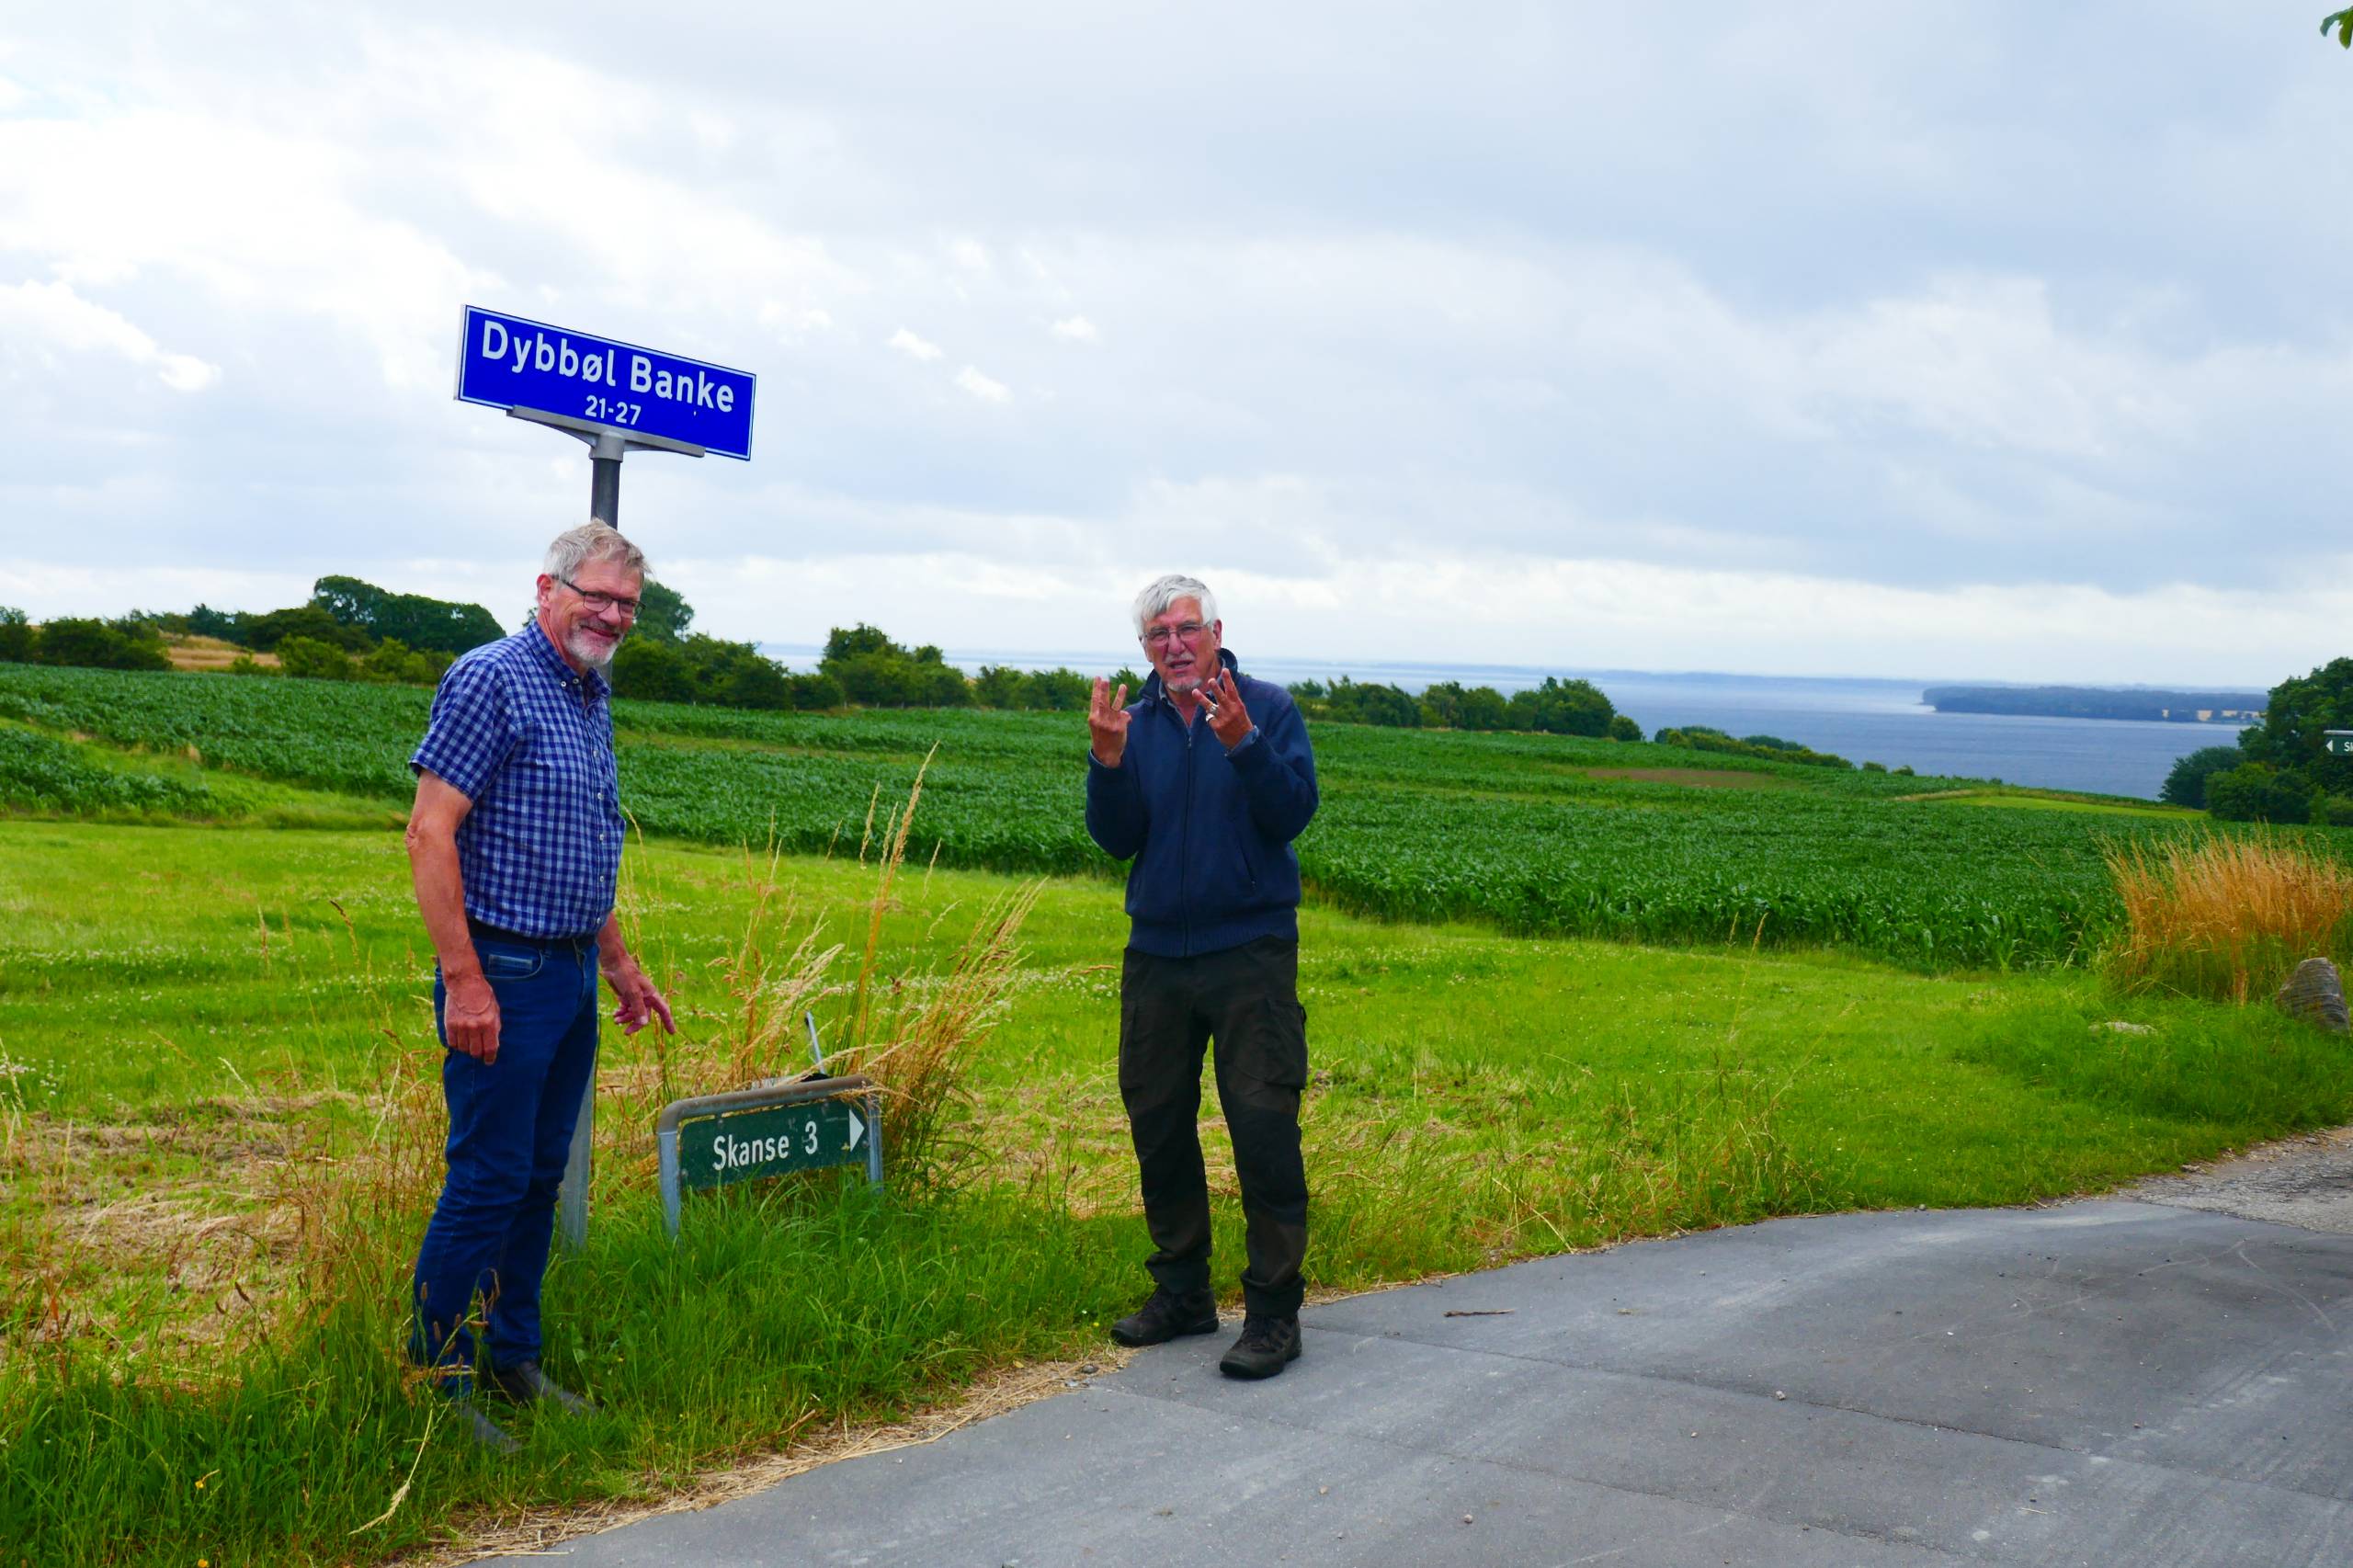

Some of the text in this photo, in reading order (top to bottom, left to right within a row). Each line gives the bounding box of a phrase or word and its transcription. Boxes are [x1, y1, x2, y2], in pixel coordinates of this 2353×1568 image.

[483, 320, 734, 412] Dybbøl Banke
[585, 395, 642, 425] 21-27
[712, 1120, 818, 1171] Skanse 3
